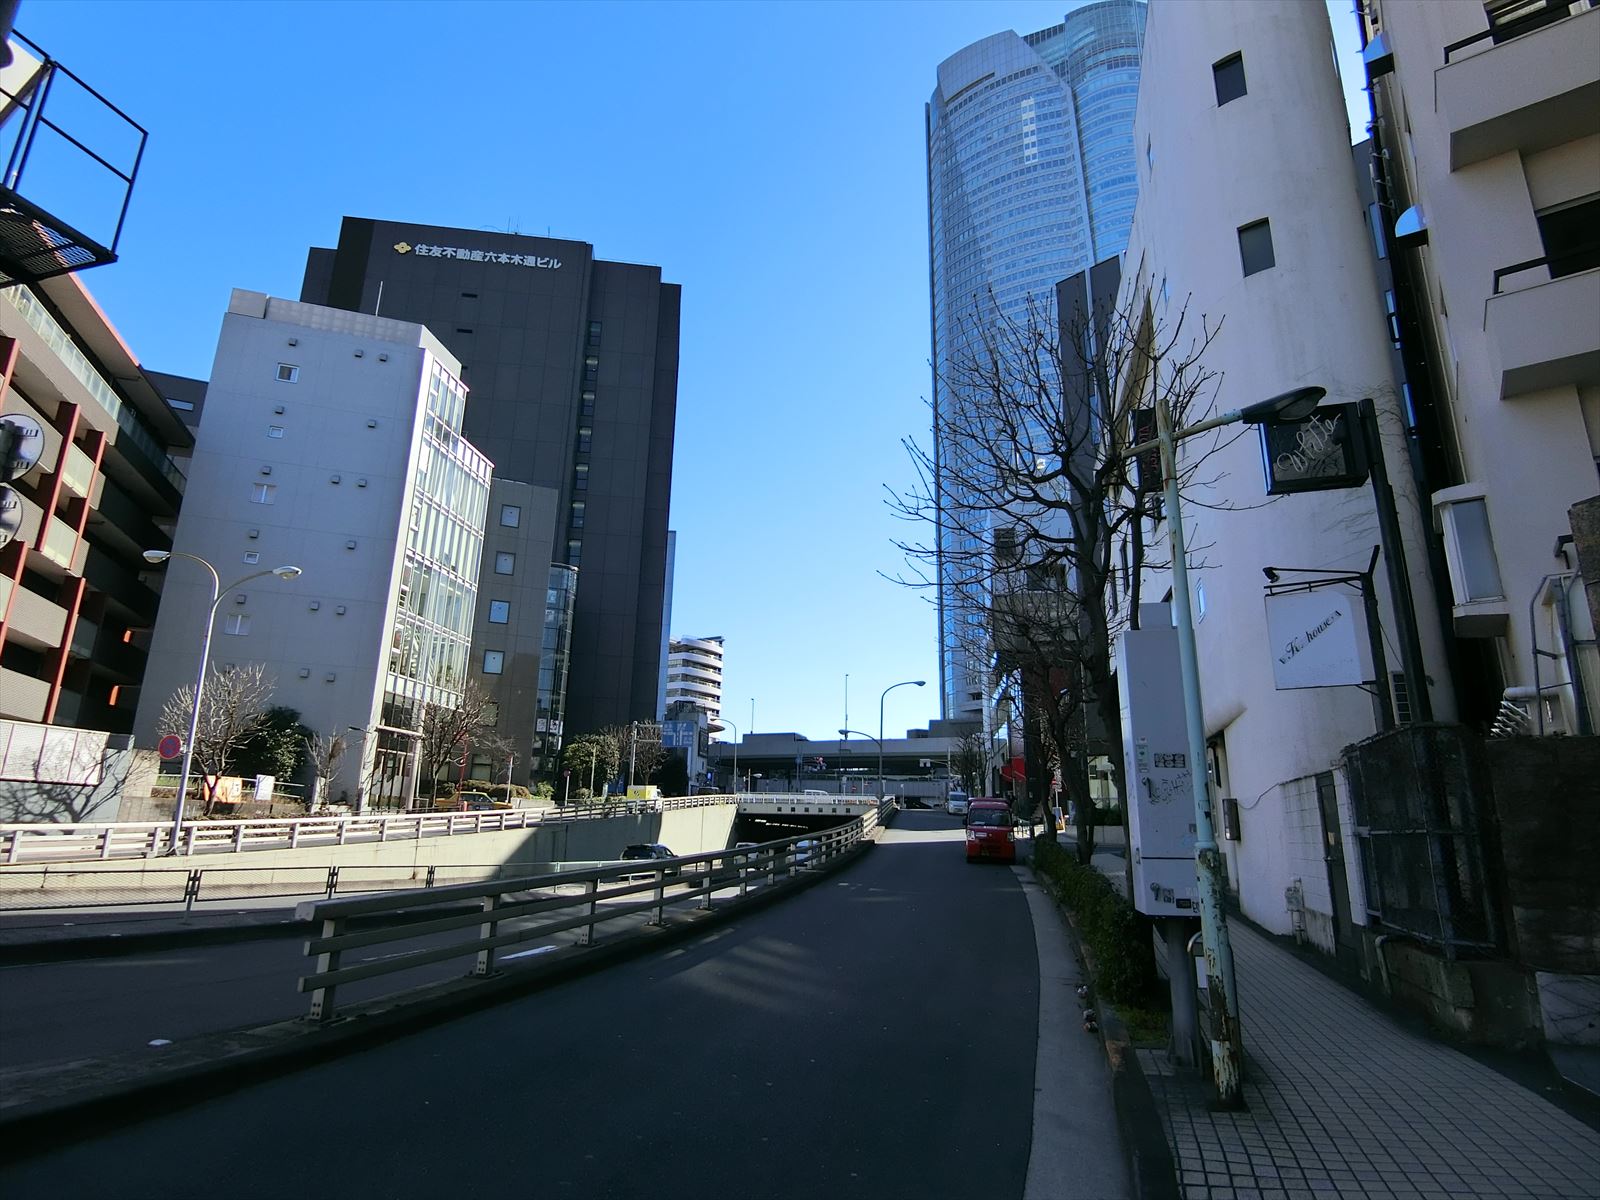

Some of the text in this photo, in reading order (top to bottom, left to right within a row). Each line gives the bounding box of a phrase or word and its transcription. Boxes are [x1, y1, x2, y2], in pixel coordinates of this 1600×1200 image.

[414, 243, 562, 269] 住友不動産六本木通ビル
